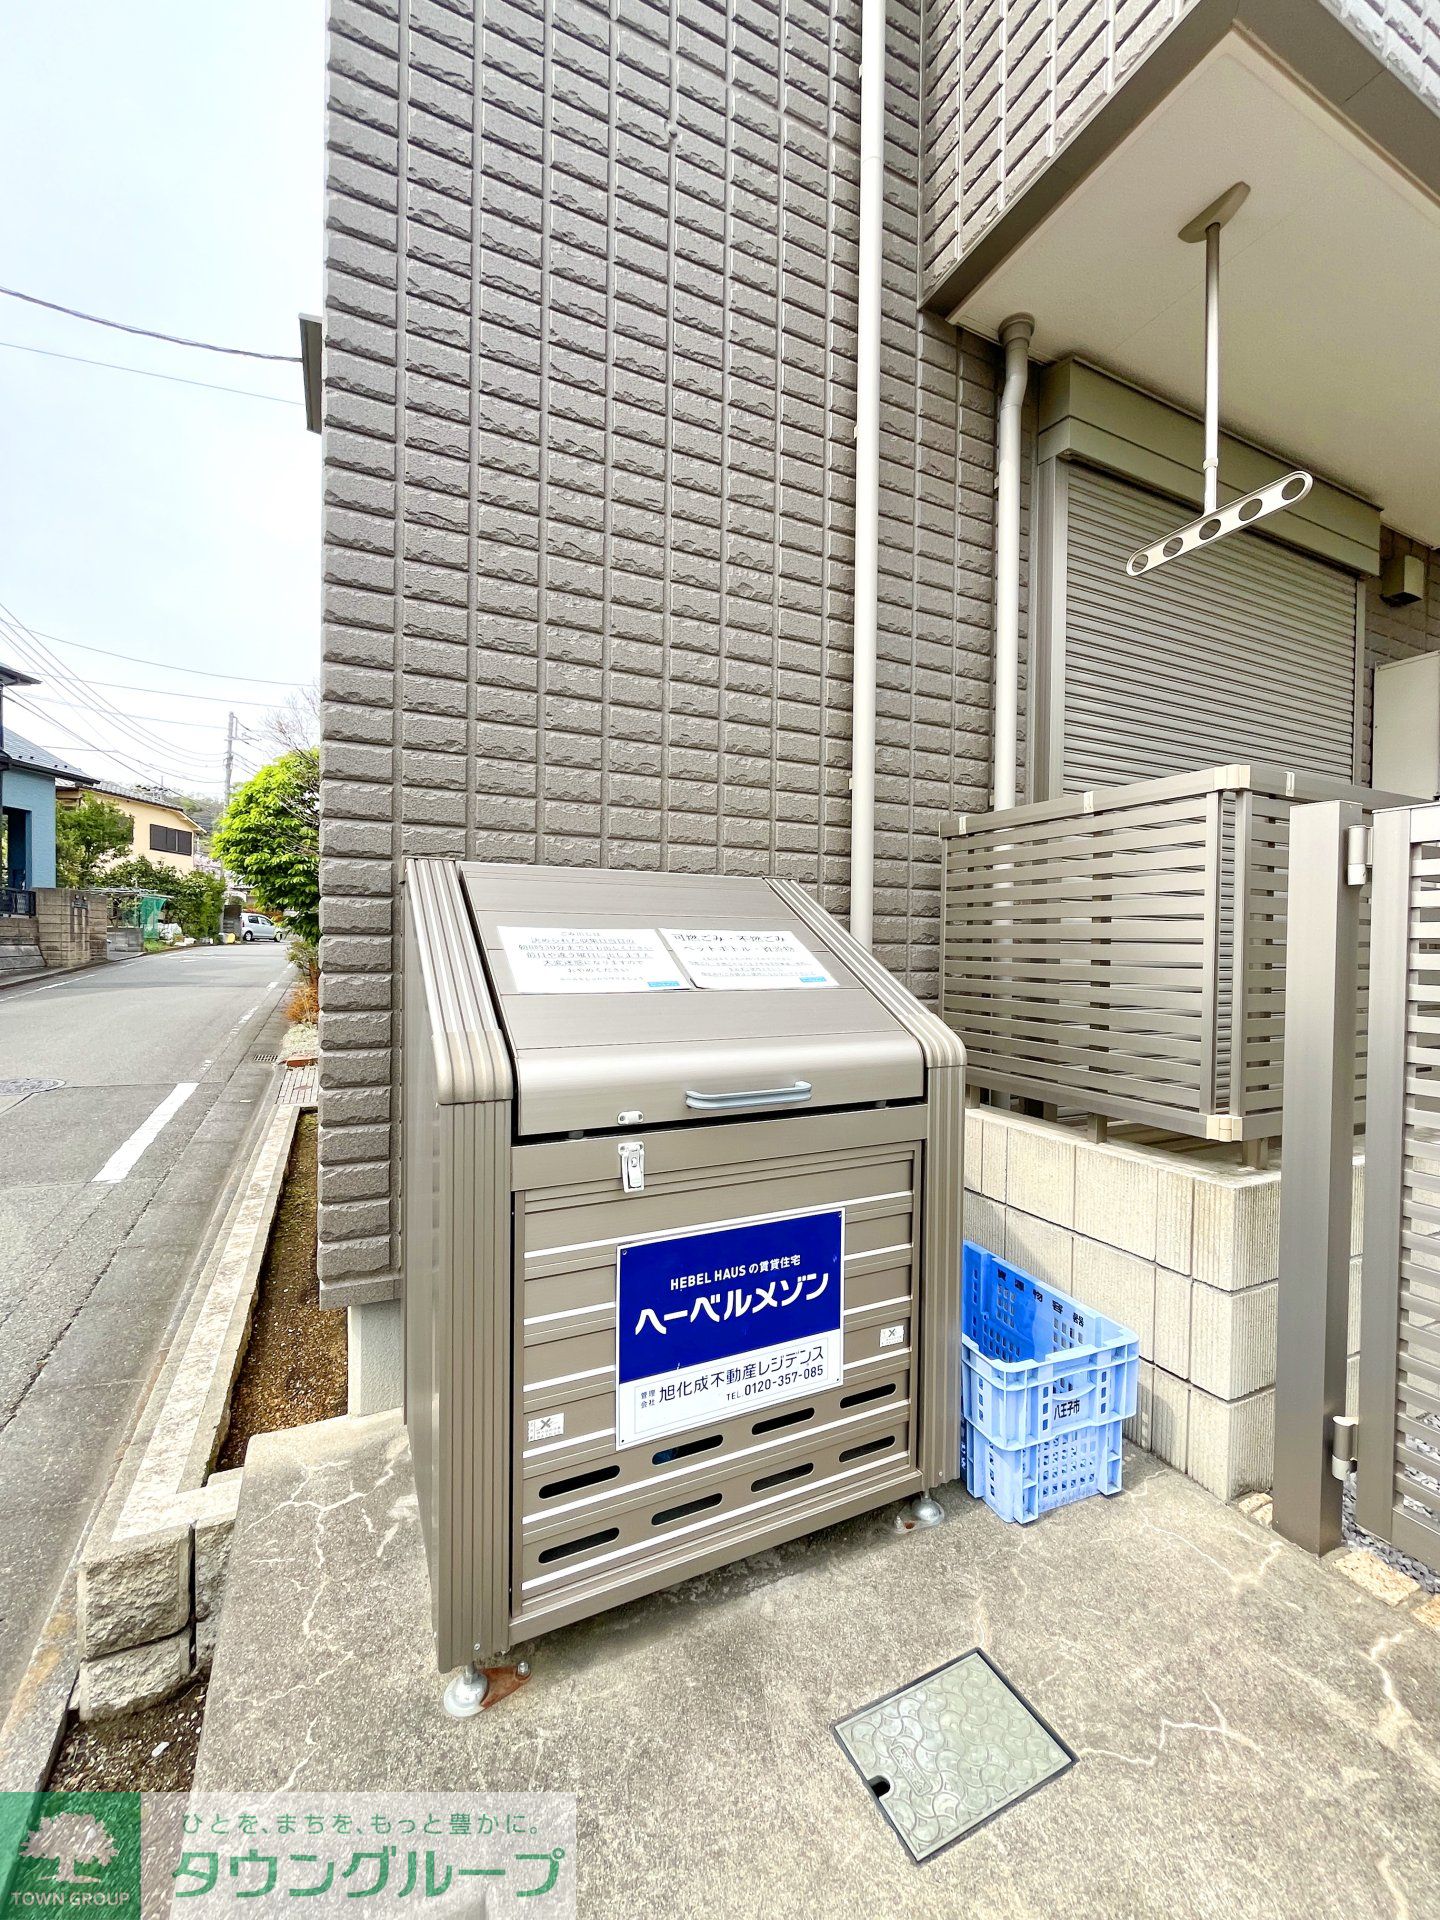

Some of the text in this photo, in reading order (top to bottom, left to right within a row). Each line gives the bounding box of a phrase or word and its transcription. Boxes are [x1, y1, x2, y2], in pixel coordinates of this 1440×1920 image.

[670, 1254, 801, 1291] HEBEL HAUS の賃貸住宅
[635, 1273, 829, 1336] ヘーベルメゾン
[659, 1345, 824, 1403] 旭化成不動産レジデンス
[1053, 1400, 1081, 1421] 八王子市
